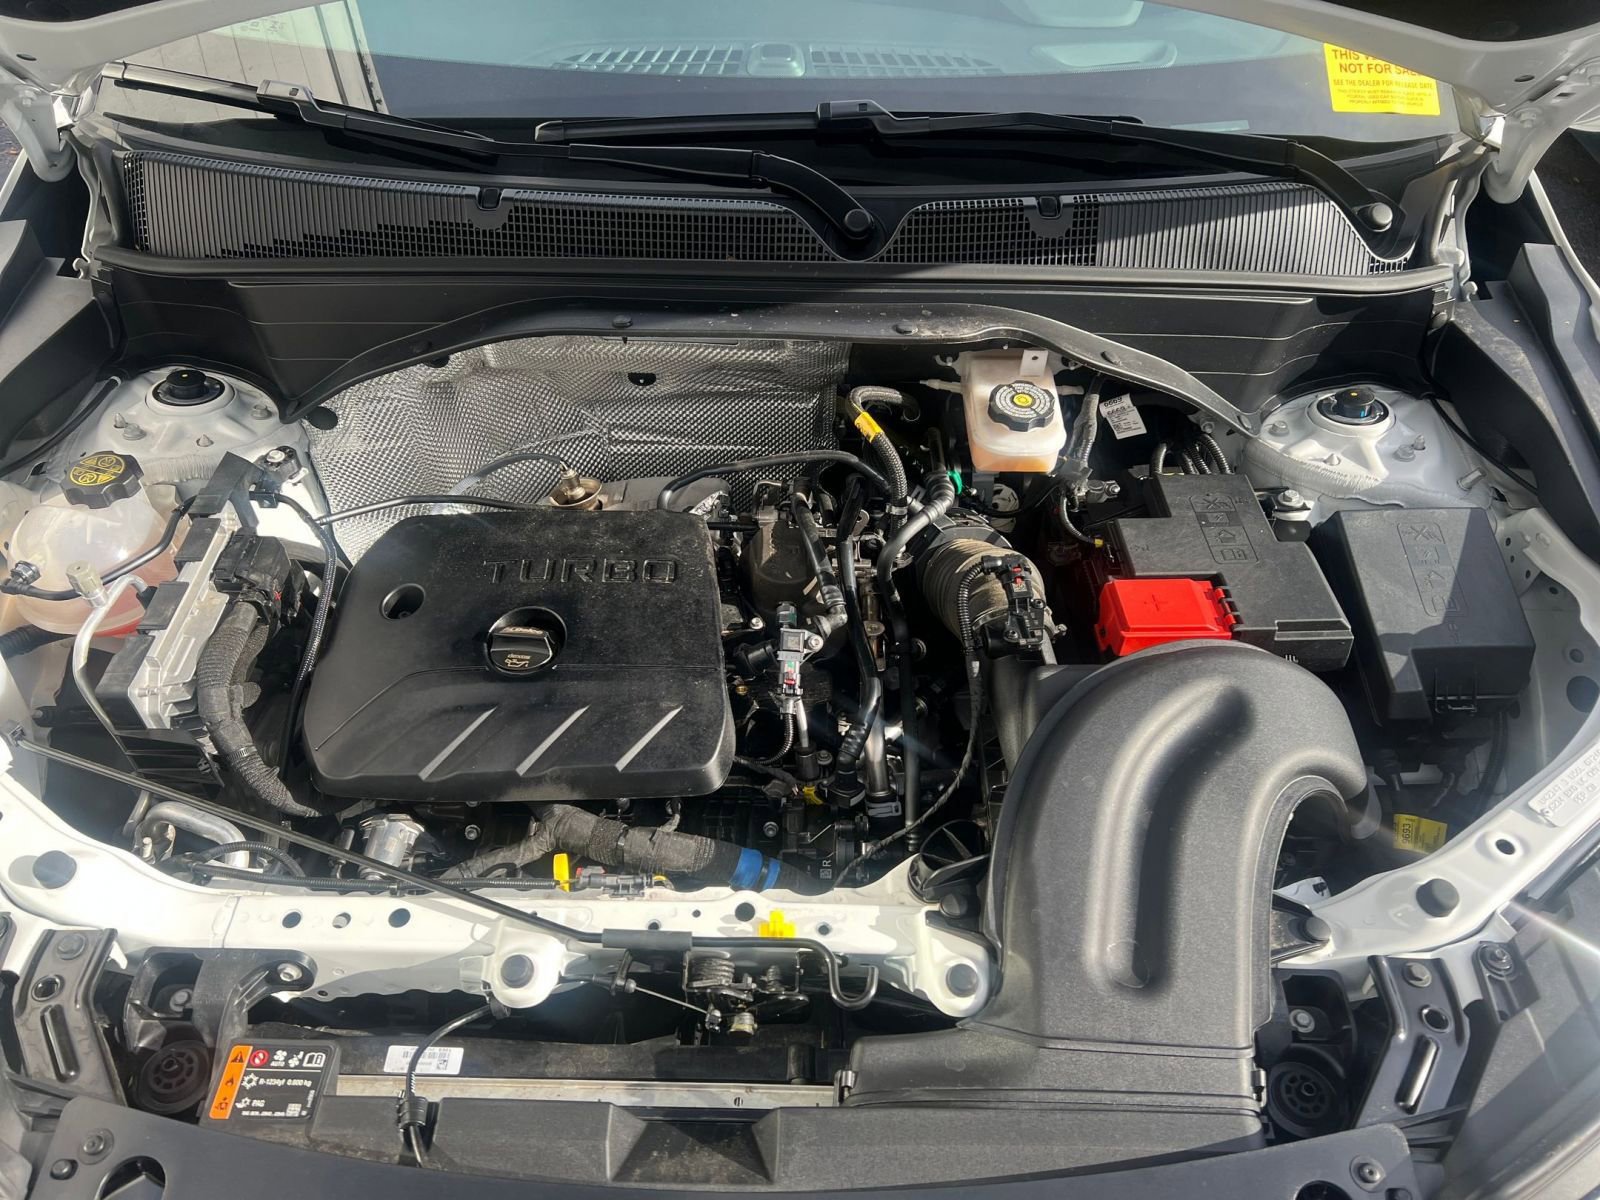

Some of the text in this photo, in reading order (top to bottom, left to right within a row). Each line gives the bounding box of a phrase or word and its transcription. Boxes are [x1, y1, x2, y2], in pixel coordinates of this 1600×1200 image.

[1332, 49, 1359, 60] THIS
[1339, 63, 1364, 73] NOT
[1367, 63, 1392, 74] FOR
[483, 557, 677, 584] TURBO
[1402, 823, 1411, 845] 9693
[304, 1079, 312, 1087] kg
[251, 1099, 266, 1107] PAG
